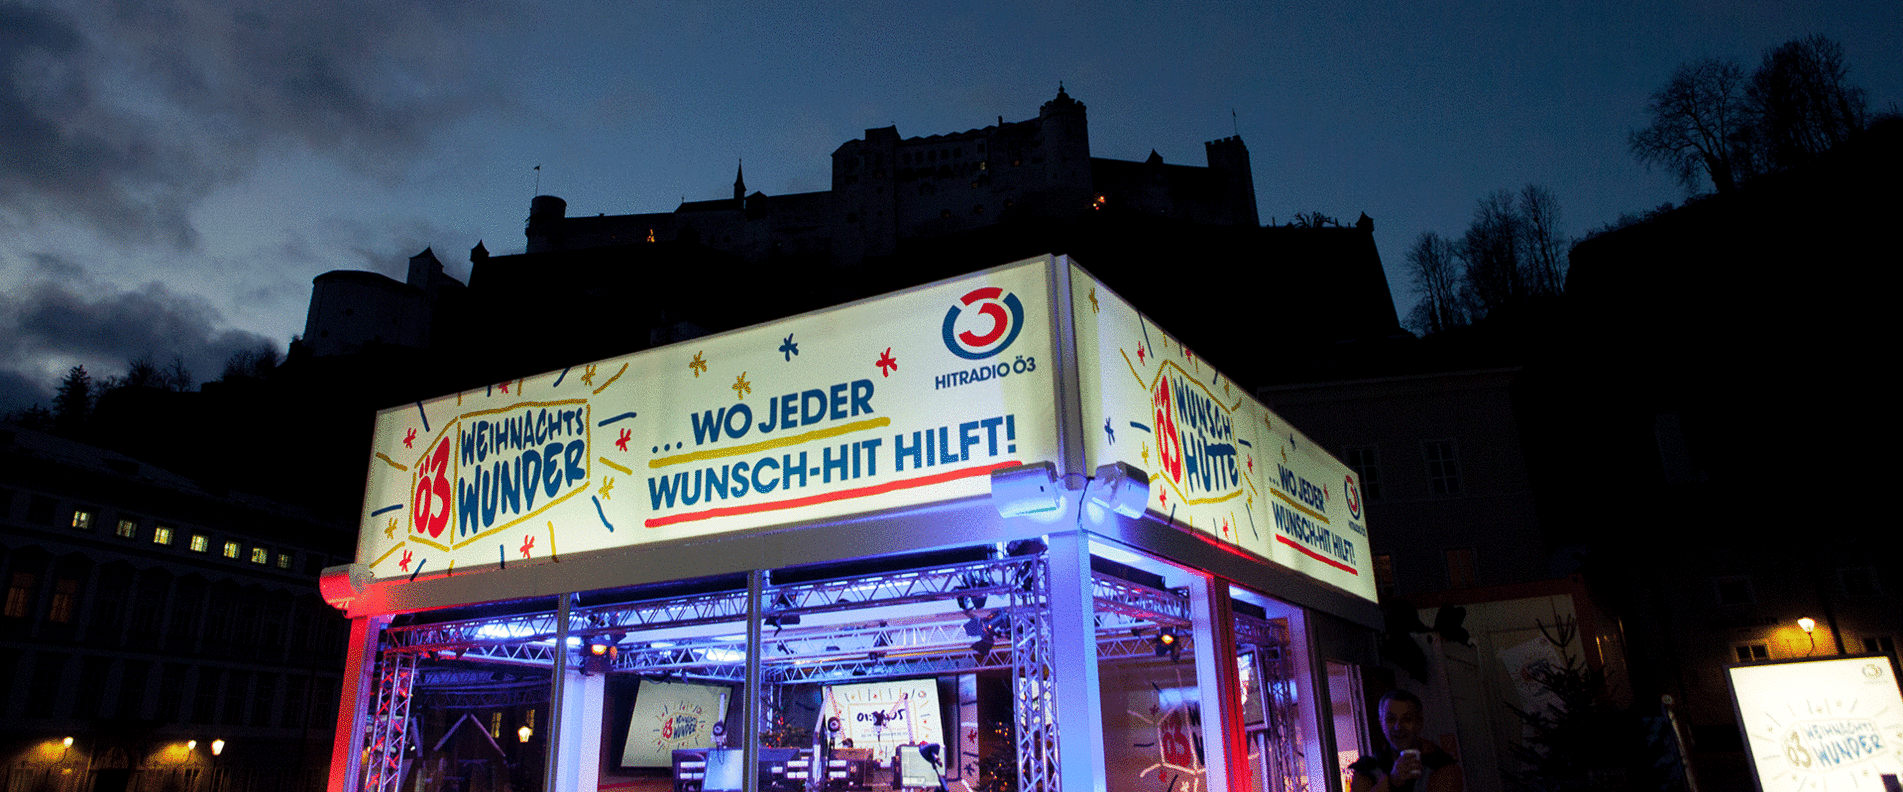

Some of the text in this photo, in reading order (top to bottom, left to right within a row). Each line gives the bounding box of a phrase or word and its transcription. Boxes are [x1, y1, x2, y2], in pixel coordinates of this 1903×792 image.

[935, 355, 1036, 390] HITRADIO Ö3
[461, 407, 584, 467] WEIHNACHTS
[691, 403, 752, 445] WO
[758, 379, 874, 433] JEDER
[1154, 375, 1181, 484] Ö3
[1174, 375, 1232, 440] WUNSCH
[414, 436, 451, 538] Ö3
[458, 439, 585, 537] WUNDER
[648, 414, 1016, 510] WUNSCH-HIT HILFT!
[1181, 427, 1239, 493] HÜTTE
[1298, 476, 1325, 513] JEDER
[1812, 733, 1884, 767] WUNDER
